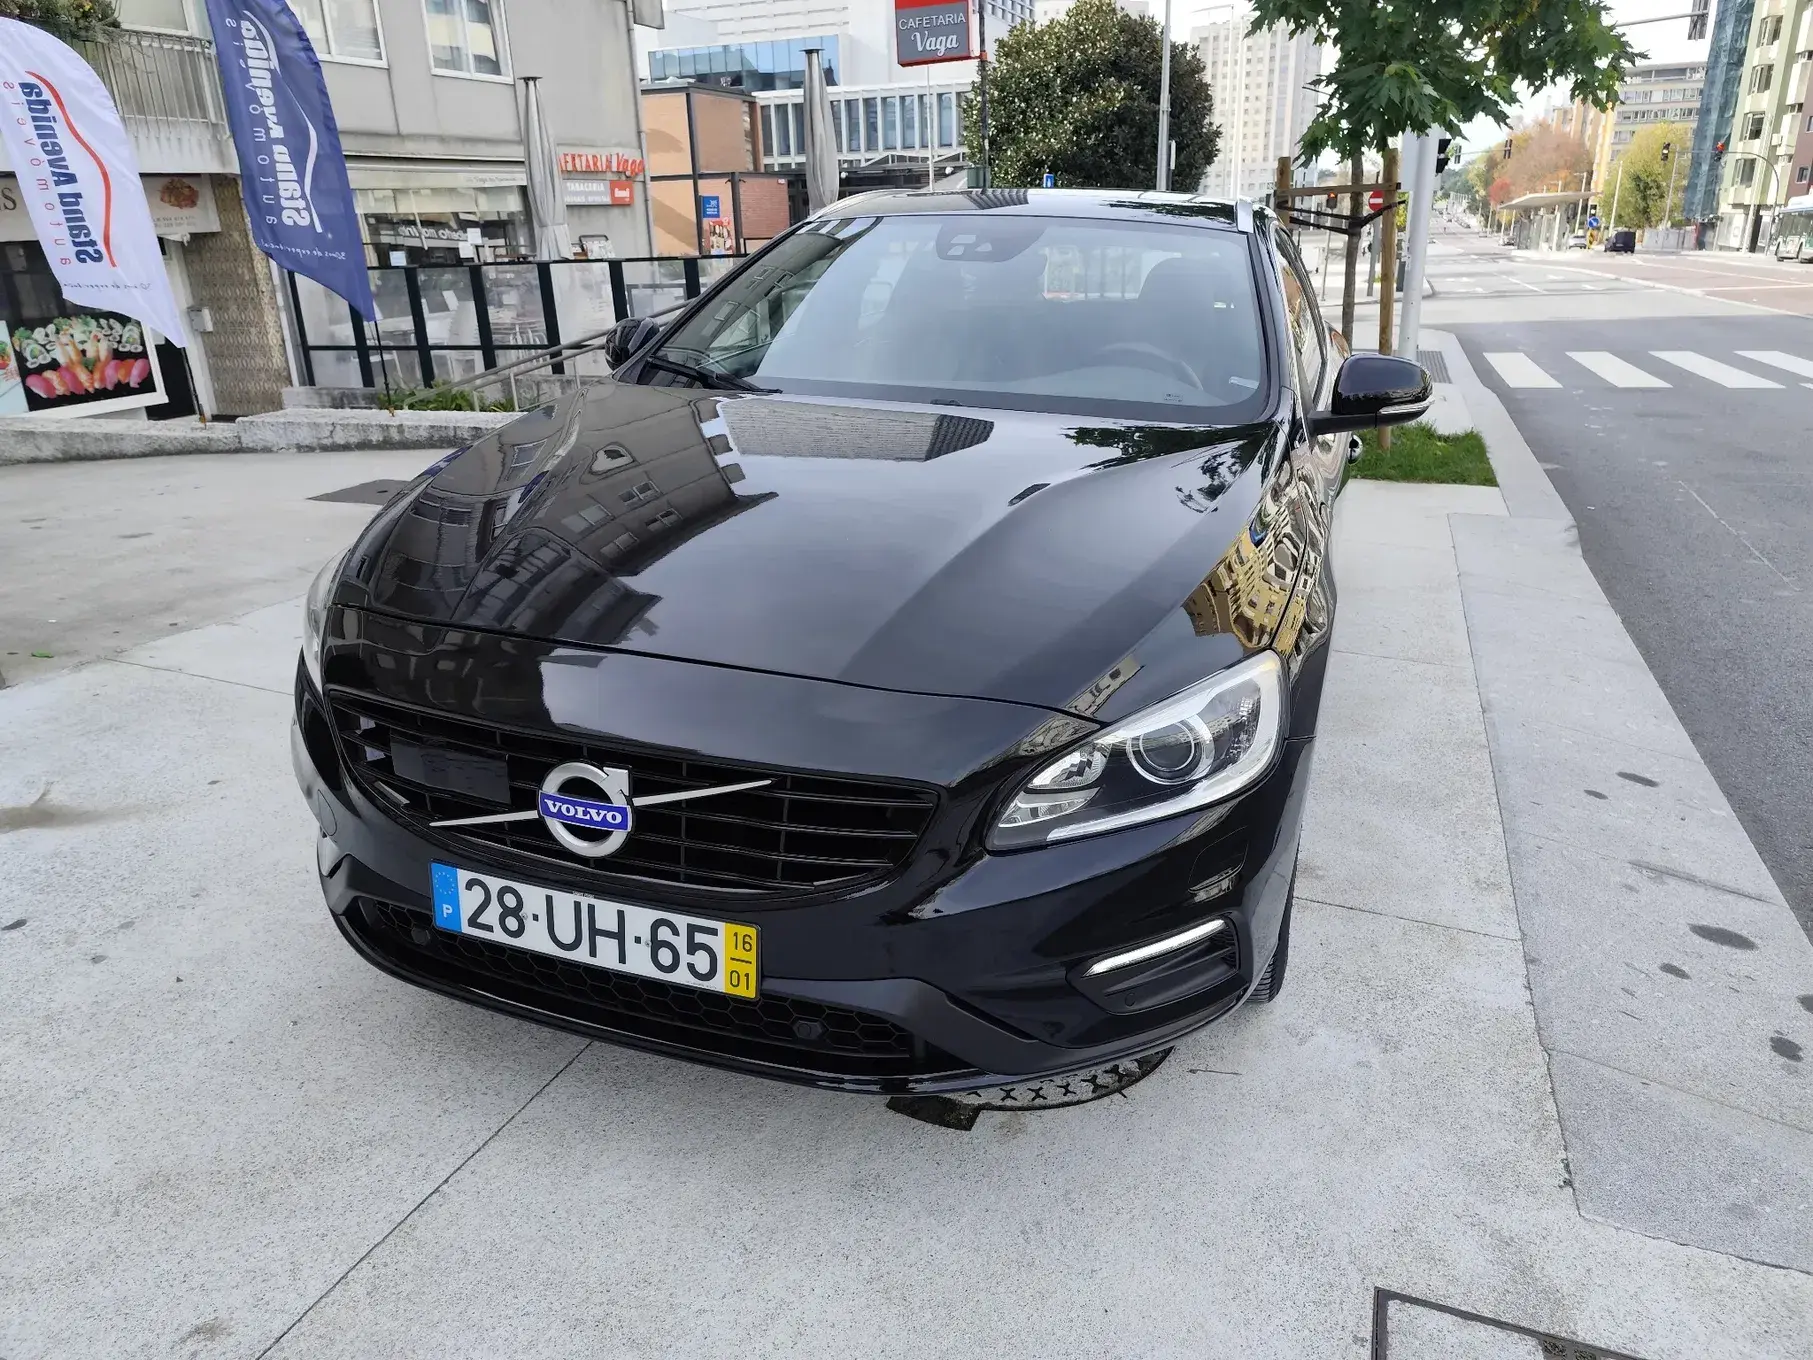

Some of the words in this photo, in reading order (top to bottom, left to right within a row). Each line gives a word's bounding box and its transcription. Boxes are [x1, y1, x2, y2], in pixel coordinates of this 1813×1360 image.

[899, 12, 966, 30] CAFETARIA
[911, 30, 959, 57] Vaga
[544, 799, 622, 824] VOLVO
[442, 903, 453, 918] P
[733, 931, 753, 952] 16
[729, 970, 750, 991] 01
